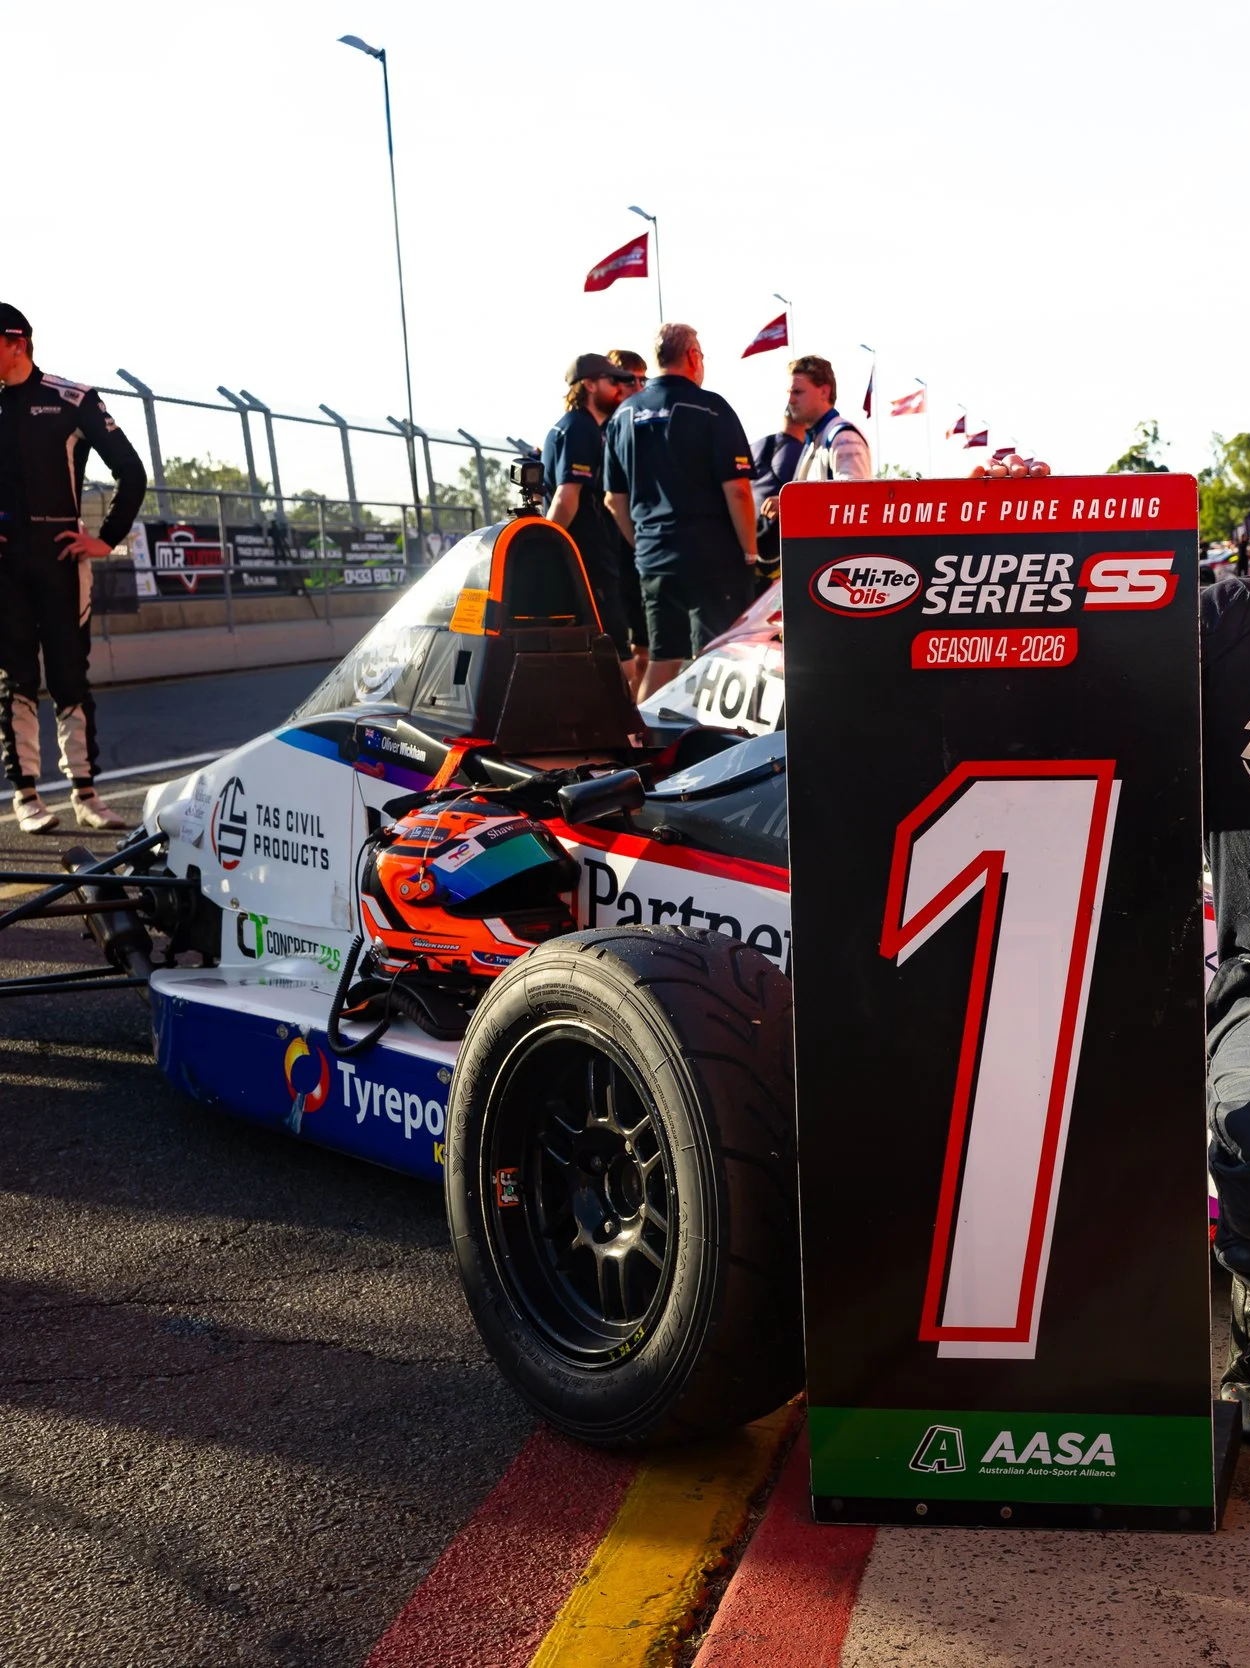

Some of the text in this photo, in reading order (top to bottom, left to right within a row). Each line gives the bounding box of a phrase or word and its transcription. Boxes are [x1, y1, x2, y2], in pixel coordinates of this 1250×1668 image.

[828, 497, 1161, 525] THE HOME OF PURE RACING
[851, 568, 917, 588] Hi-Tec
[931, 554, 1074, 584] SUPER
[849, 588, 888, 605] Oils
[921, 583, 1074, 615] SERIES
[926, 637, 993, 665] SEASON
[995, 637, 1008, 662] 4
[1020, 635, 1065, 662] 2026
[381, 736, 426, 762] Oliver Wickham
[256, 803, 325, 838] TAS CIVIL
[487, 824, 515, 840] Shaw
[254, 834, 329, 870] PRODUCTS
[880, 760, 1122, 1359] 1
[453, 1017, 503, 1142] YOKOHAMA
[337, 1061, 448, 1139] Tyrepo
[981, 1431, 1116, 1466] AASA
[979, 1466, 1116, 1478] Australian Auto-Sport Alliance
